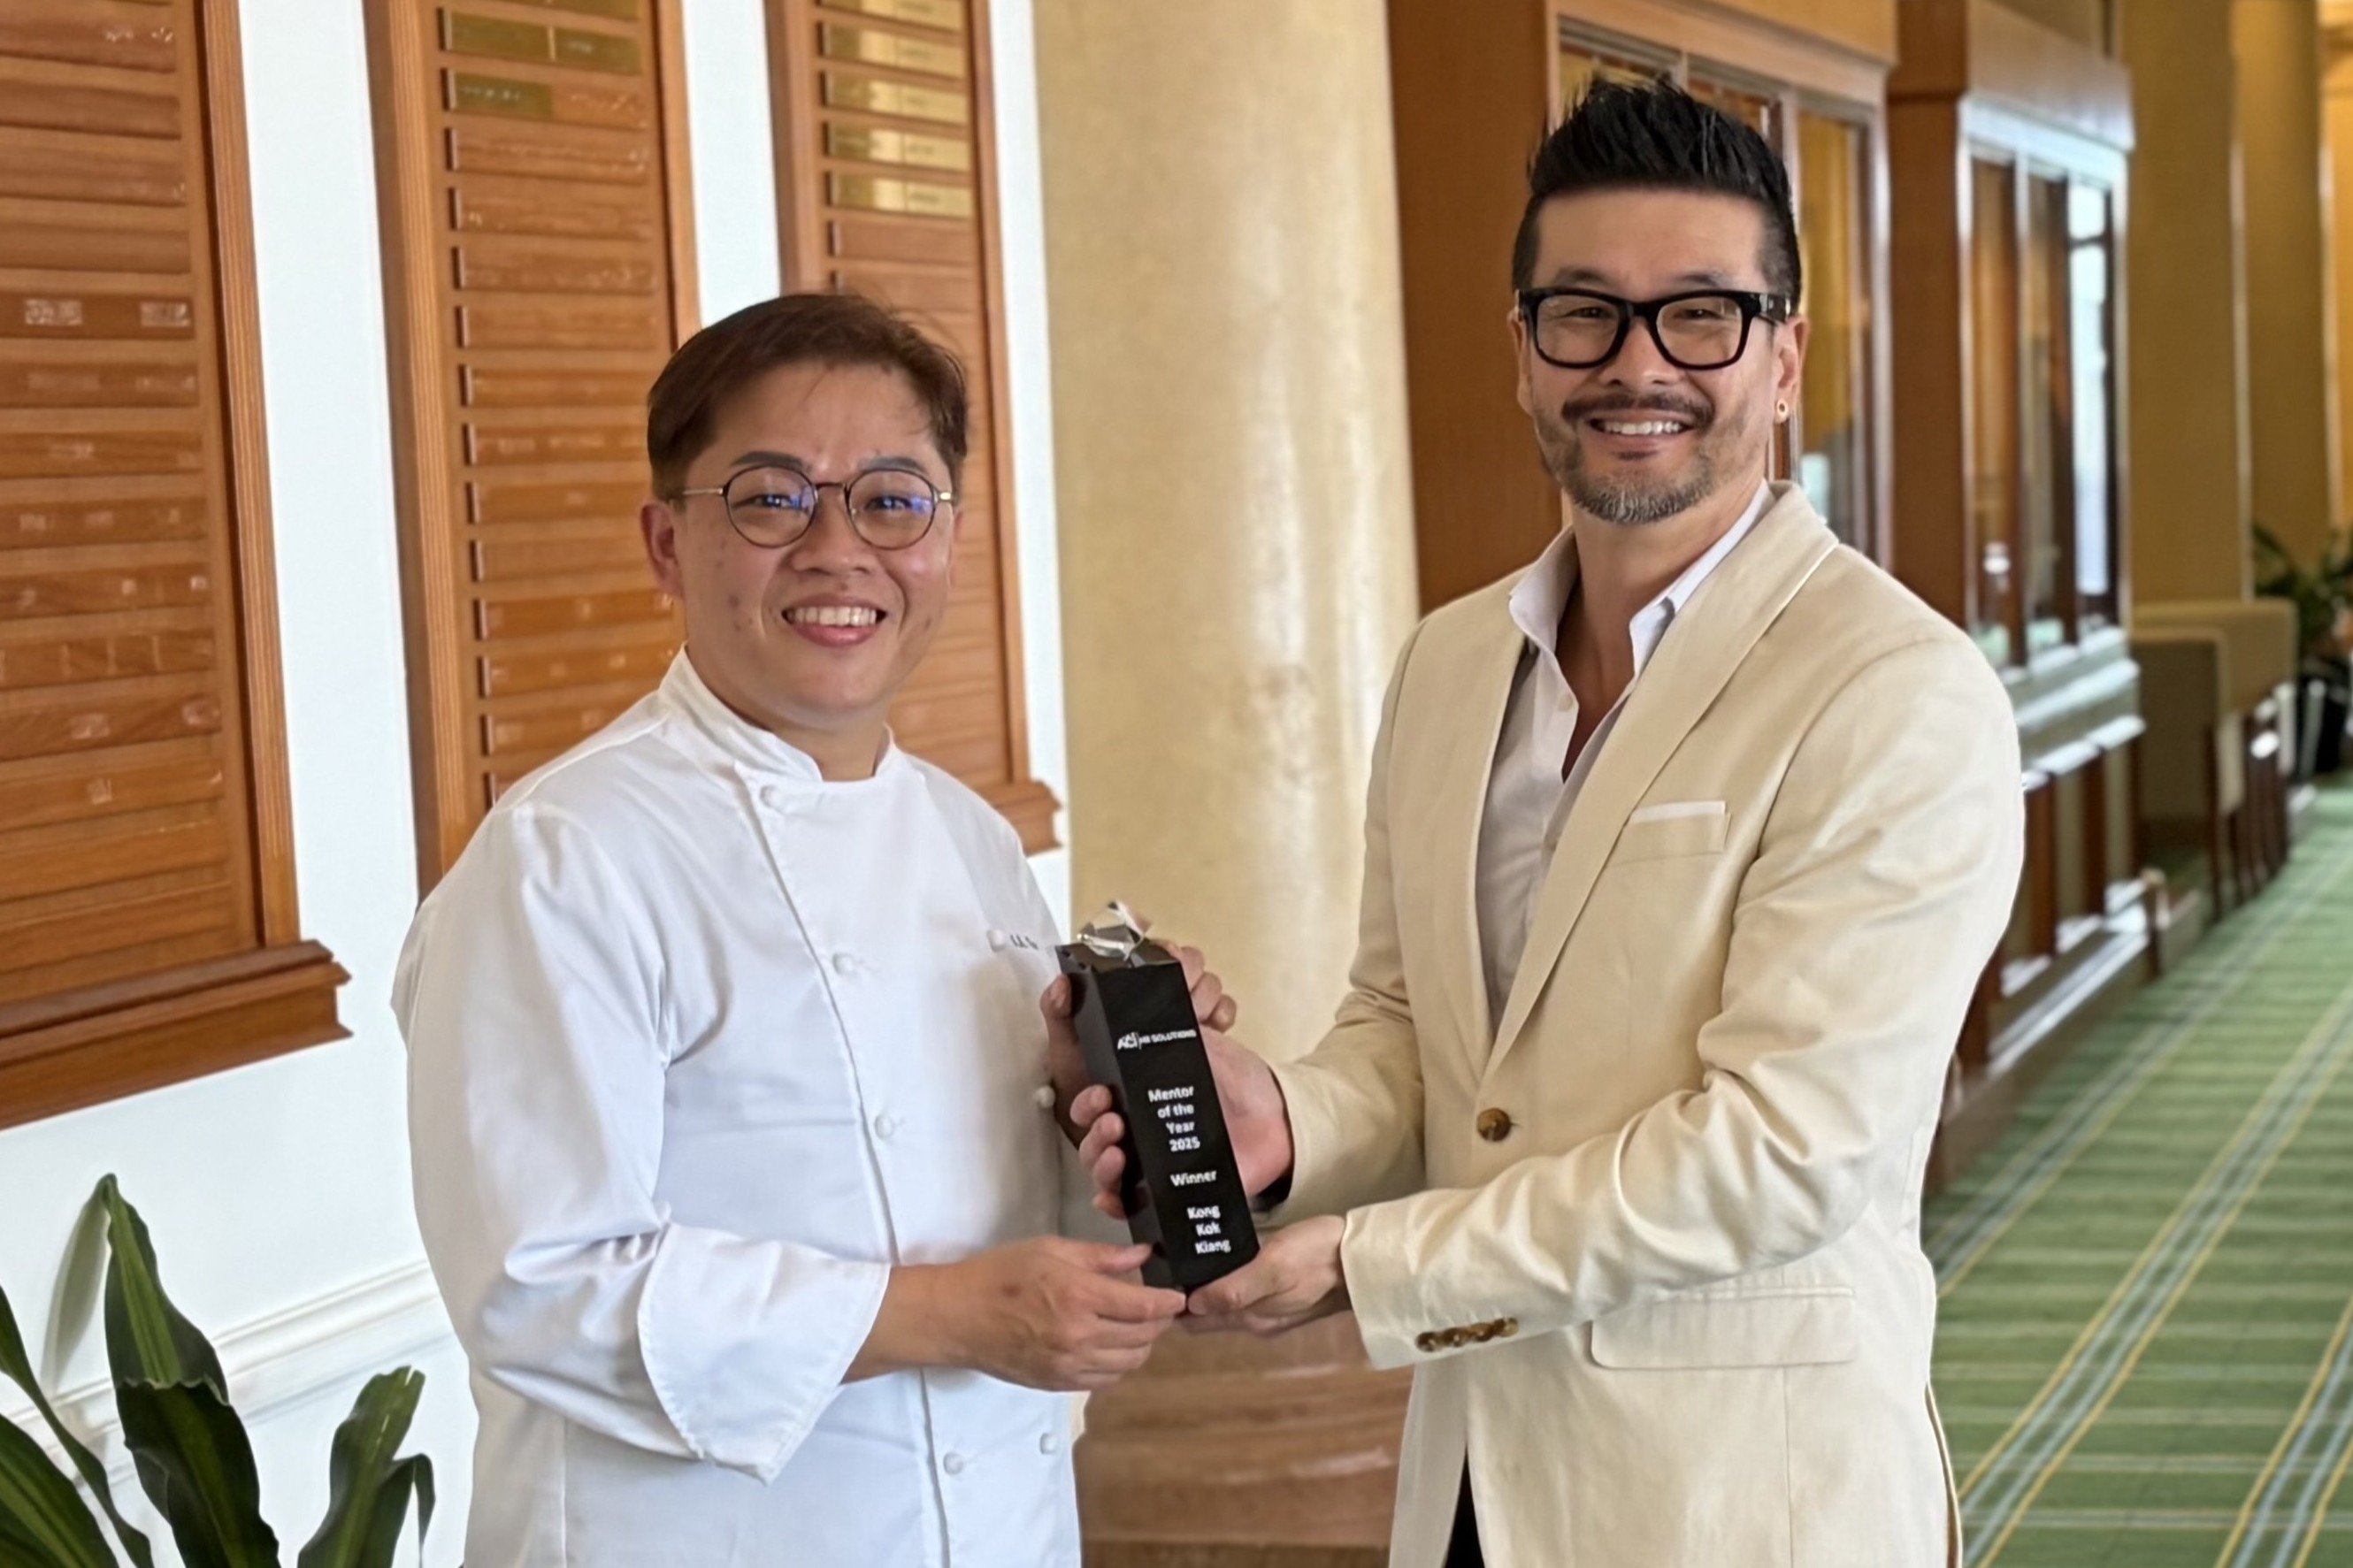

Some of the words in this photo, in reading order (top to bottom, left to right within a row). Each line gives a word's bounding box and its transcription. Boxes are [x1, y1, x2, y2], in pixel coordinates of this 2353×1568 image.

[1148, 1085, 1194, 1103] Mentor
[1157, 1105, 1171, 1119] of
[1173, 1103, 1194, 1116] the
[1165, 1121, 1195, 1135] Year
[1169, 1136, 1200, 1152] 2025
[1169, 1170, 1217, 1187] Winner
[1187, 1205, 1221, 1220] Kong
[1195, 1221, 1221, 1236] Kok
[1195, 1240, 1231, 1254] Kiang
